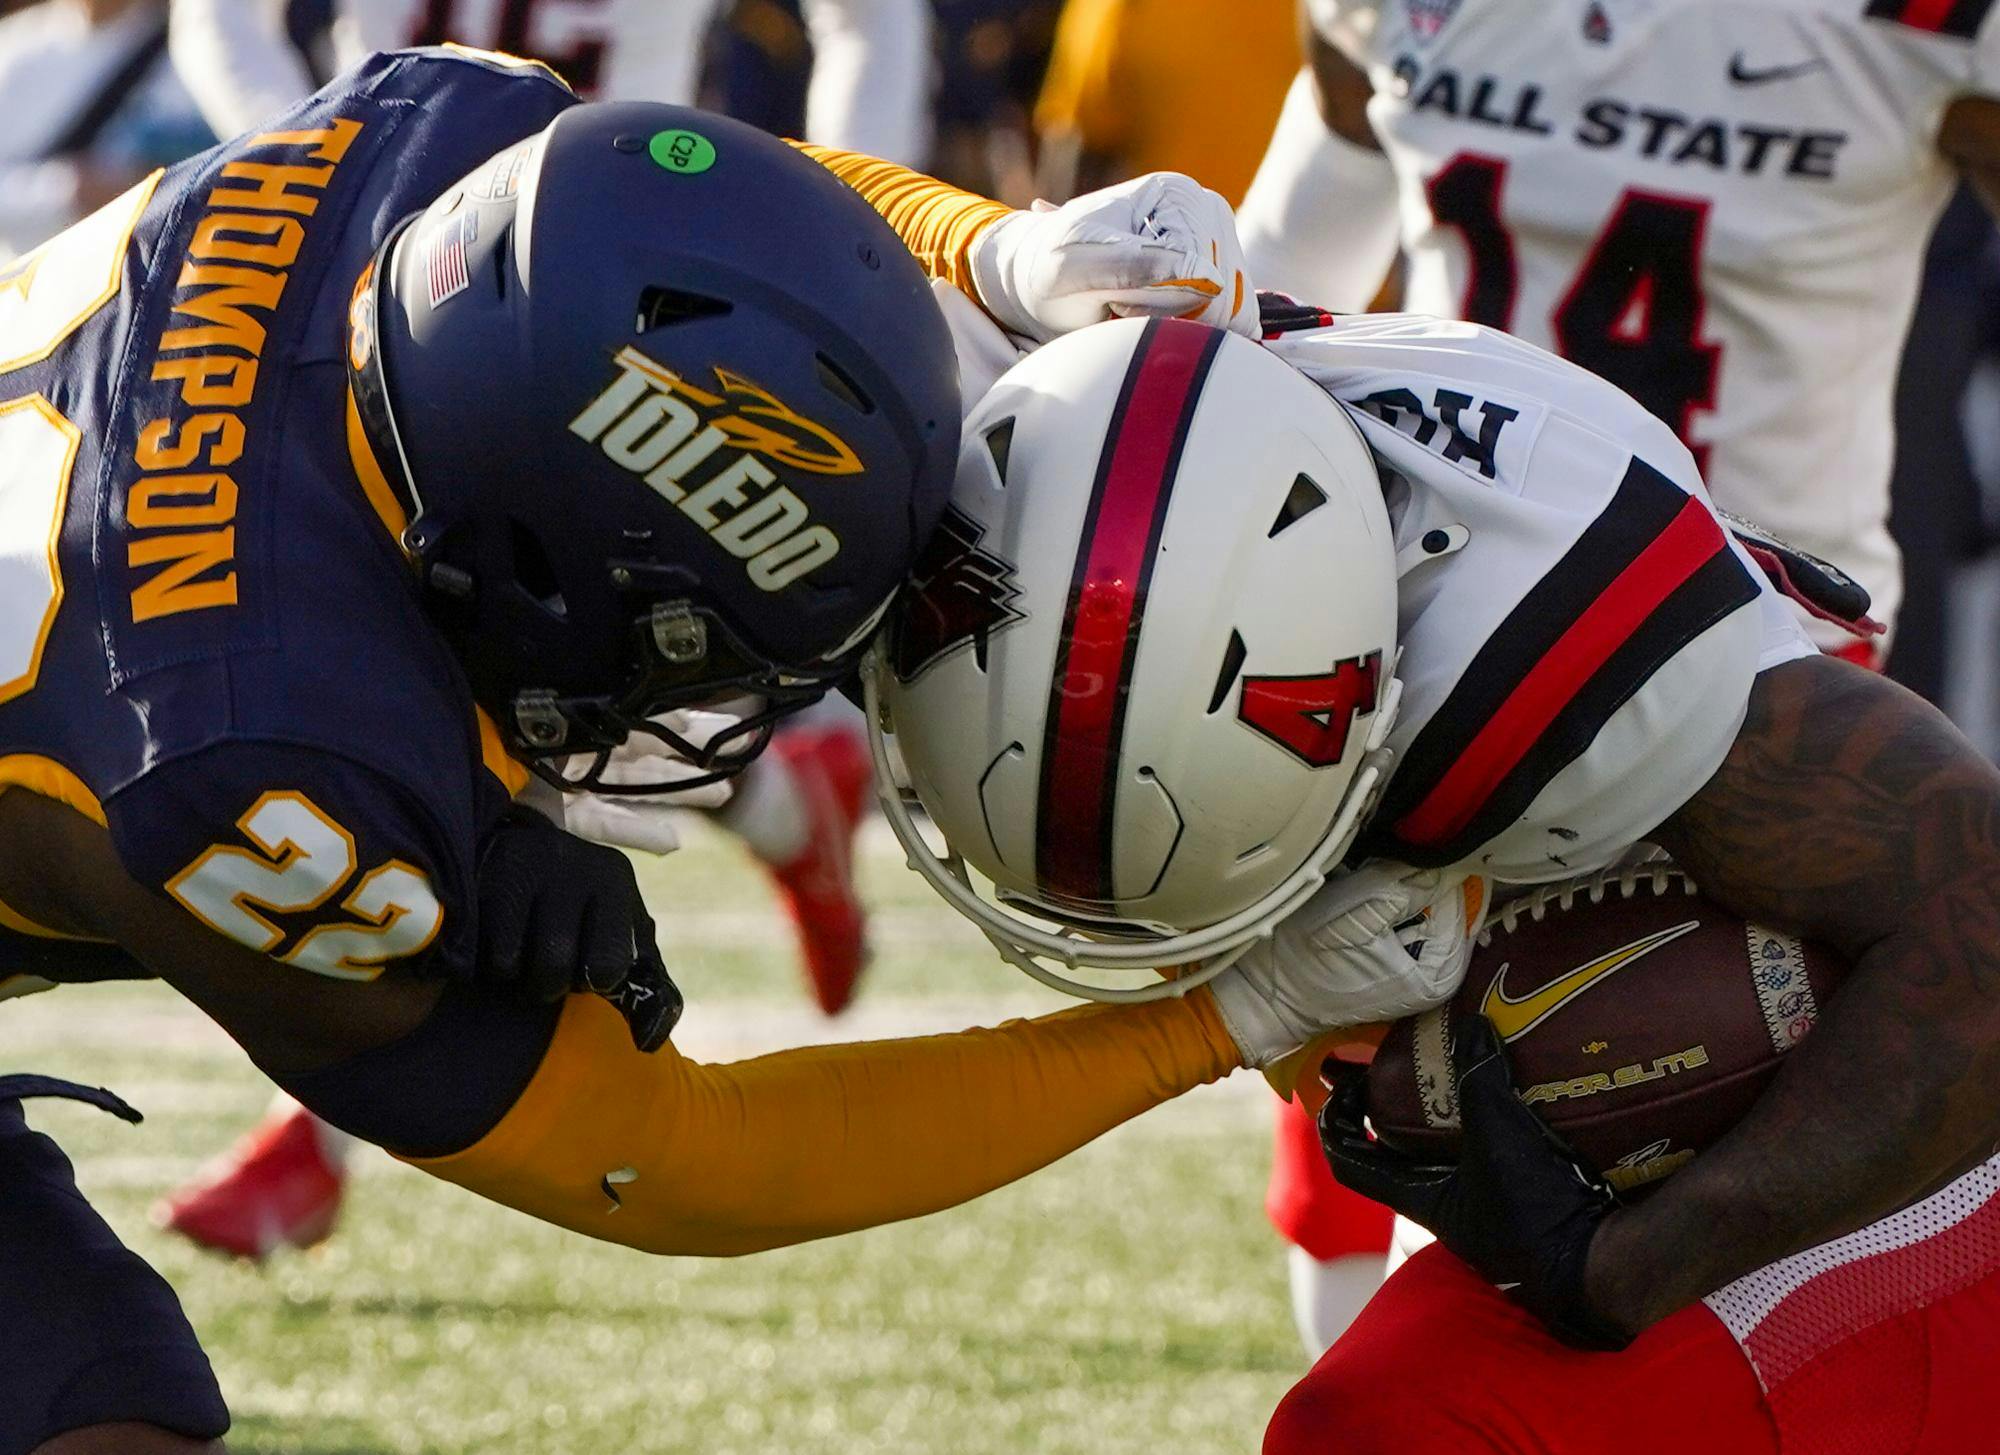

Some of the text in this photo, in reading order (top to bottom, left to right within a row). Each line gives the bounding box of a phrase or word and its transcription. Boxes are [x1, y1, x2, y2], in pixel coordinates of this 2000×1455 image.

[667, 135, 697, 168] C2P
[1573, 99, 1848, 180] STATE
[127, 118, 364, 623] THOMPSON
[1425, 149, 1723, 490] 14
[565, 343, 842, 592] TOLEDO
[1233, 648, 1383, 771] 4
[164, 789, 444, 982] 22
[1612, 1045, 1710, 1089] ELITE
